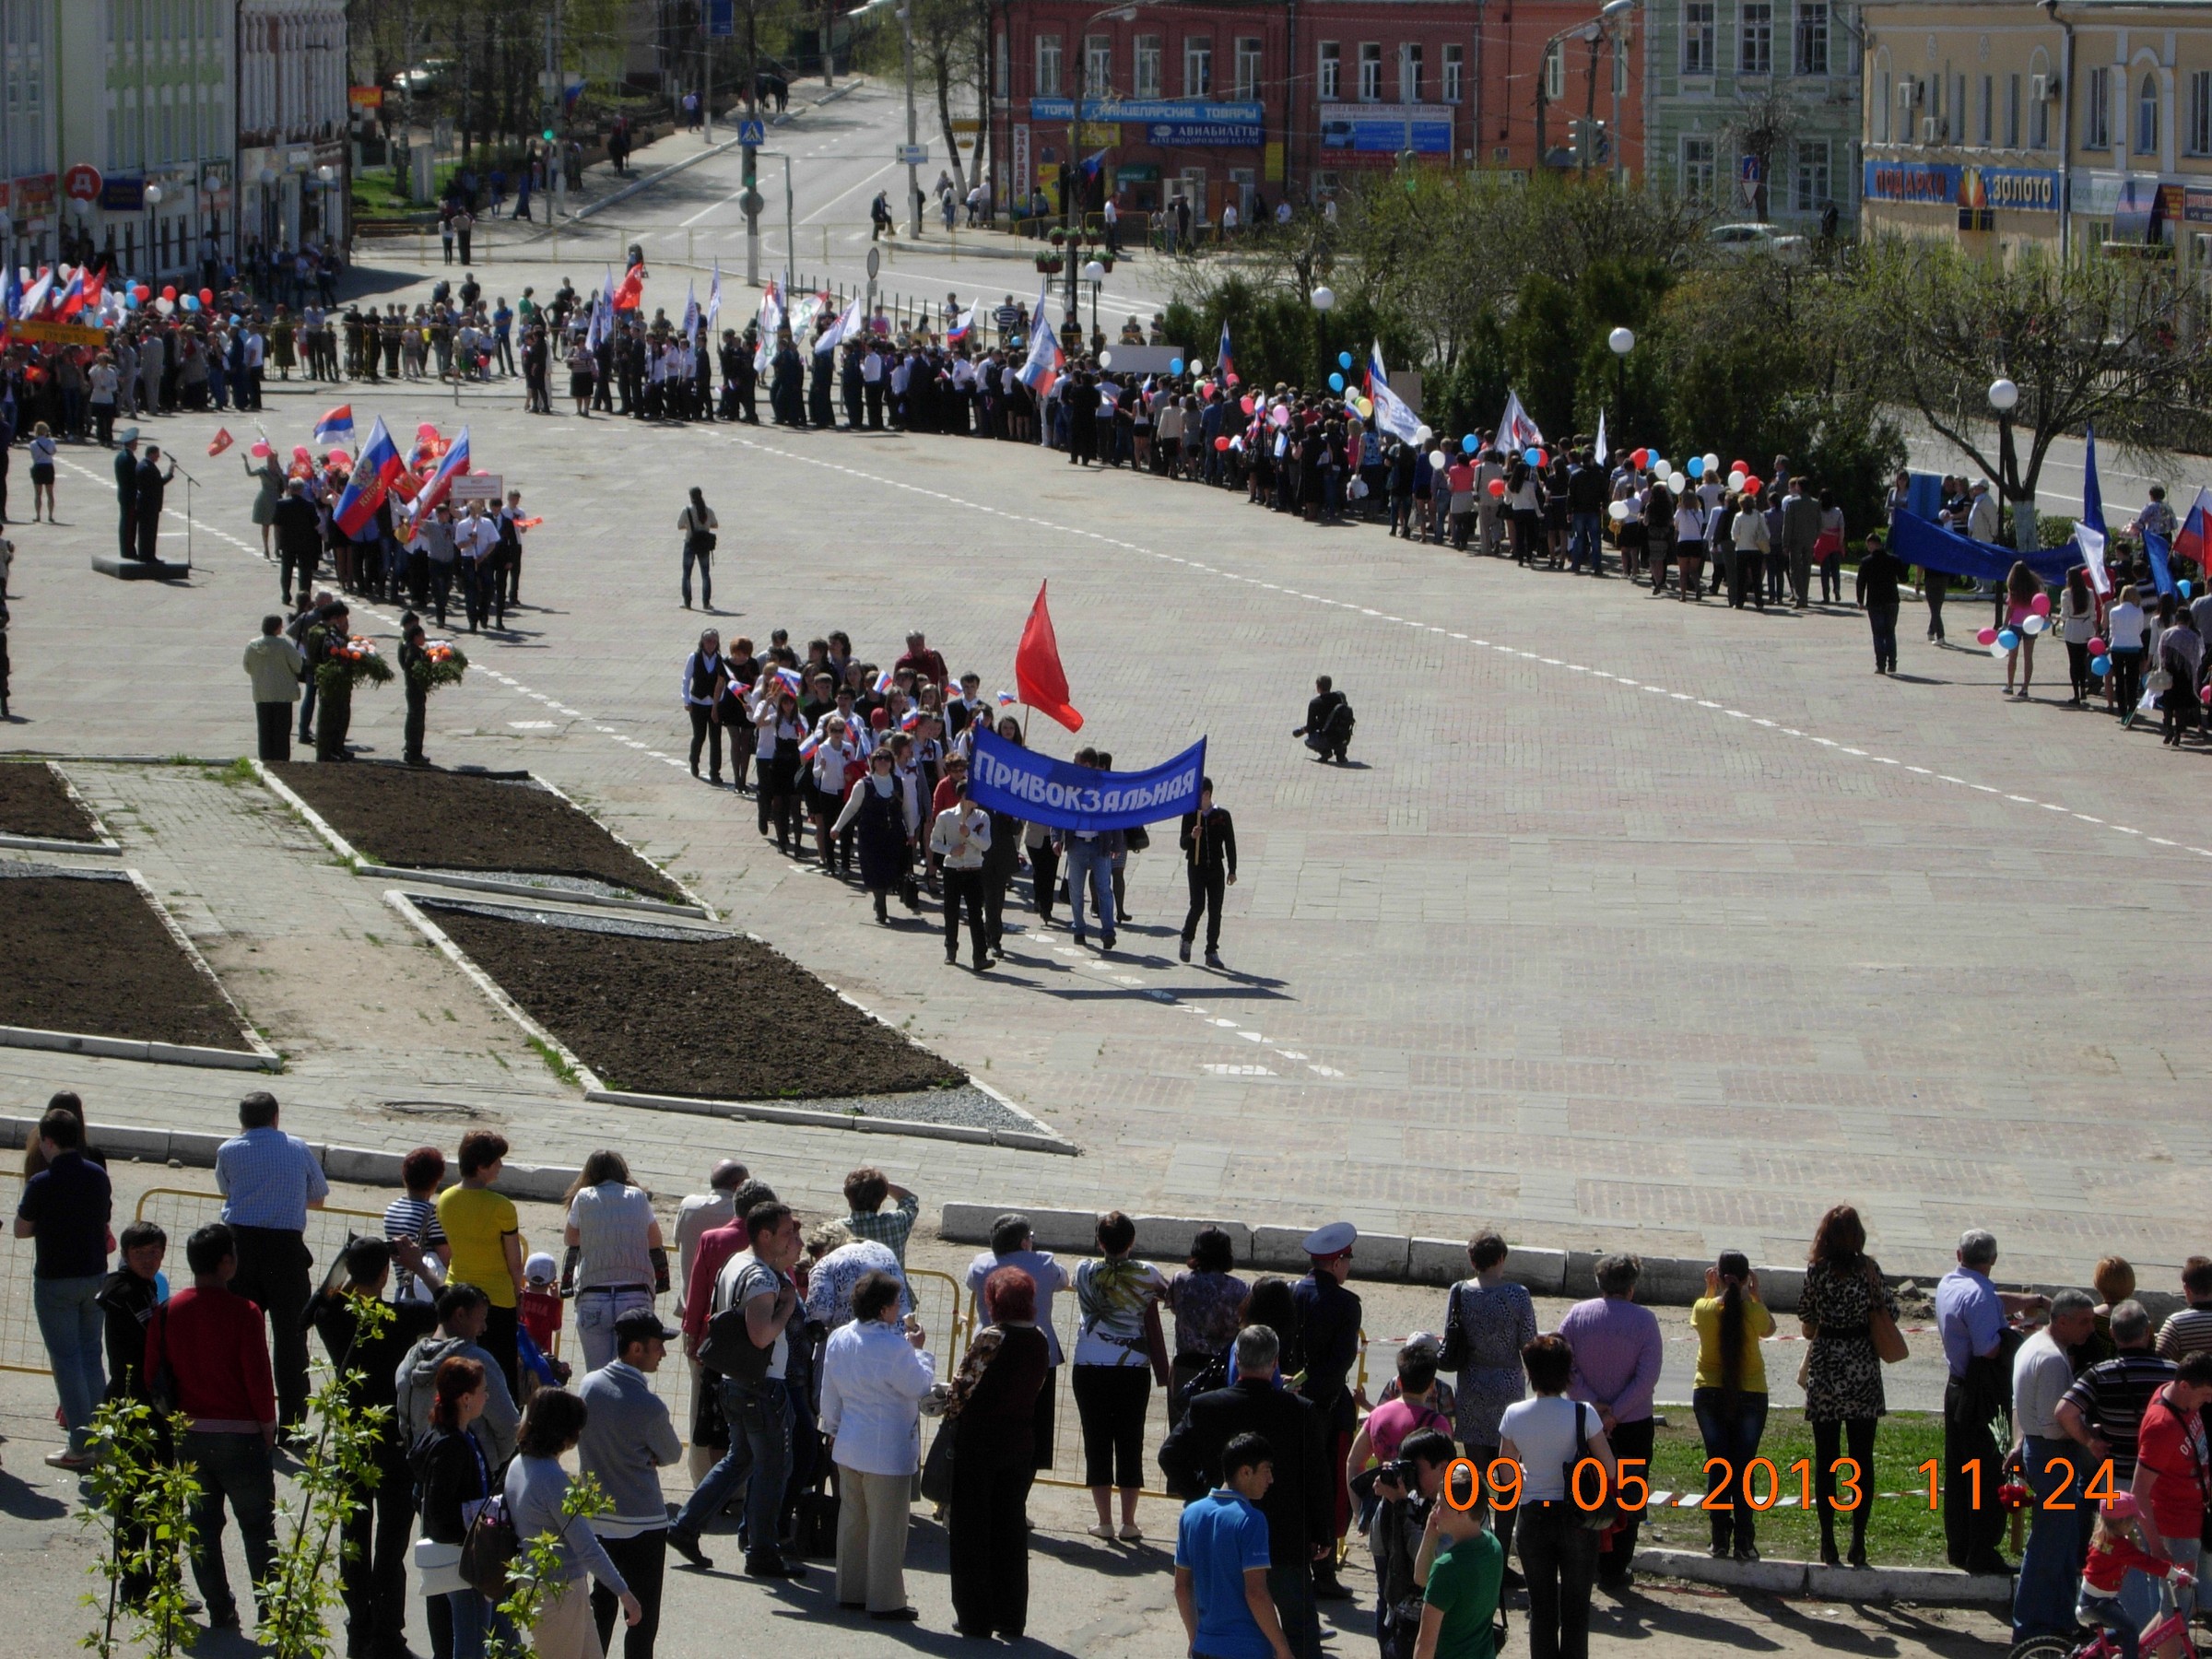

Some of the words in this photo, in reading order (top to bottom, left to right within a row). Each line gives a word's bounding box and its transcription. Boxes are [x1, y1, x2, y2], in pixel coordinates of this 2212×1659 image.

[1205, 107, 1257, 119] ТОВАРЫ
[1179, 126, 1260, 136] АВИАБИЛЕТЫ
[1875, 169, 1947, 197] ПОДАРКИ
[1993, 175, 2052, 203] ЗОЛОТО
[973, 748, 1196, 813] ПРИВОКЗАЛЬНАЯ
